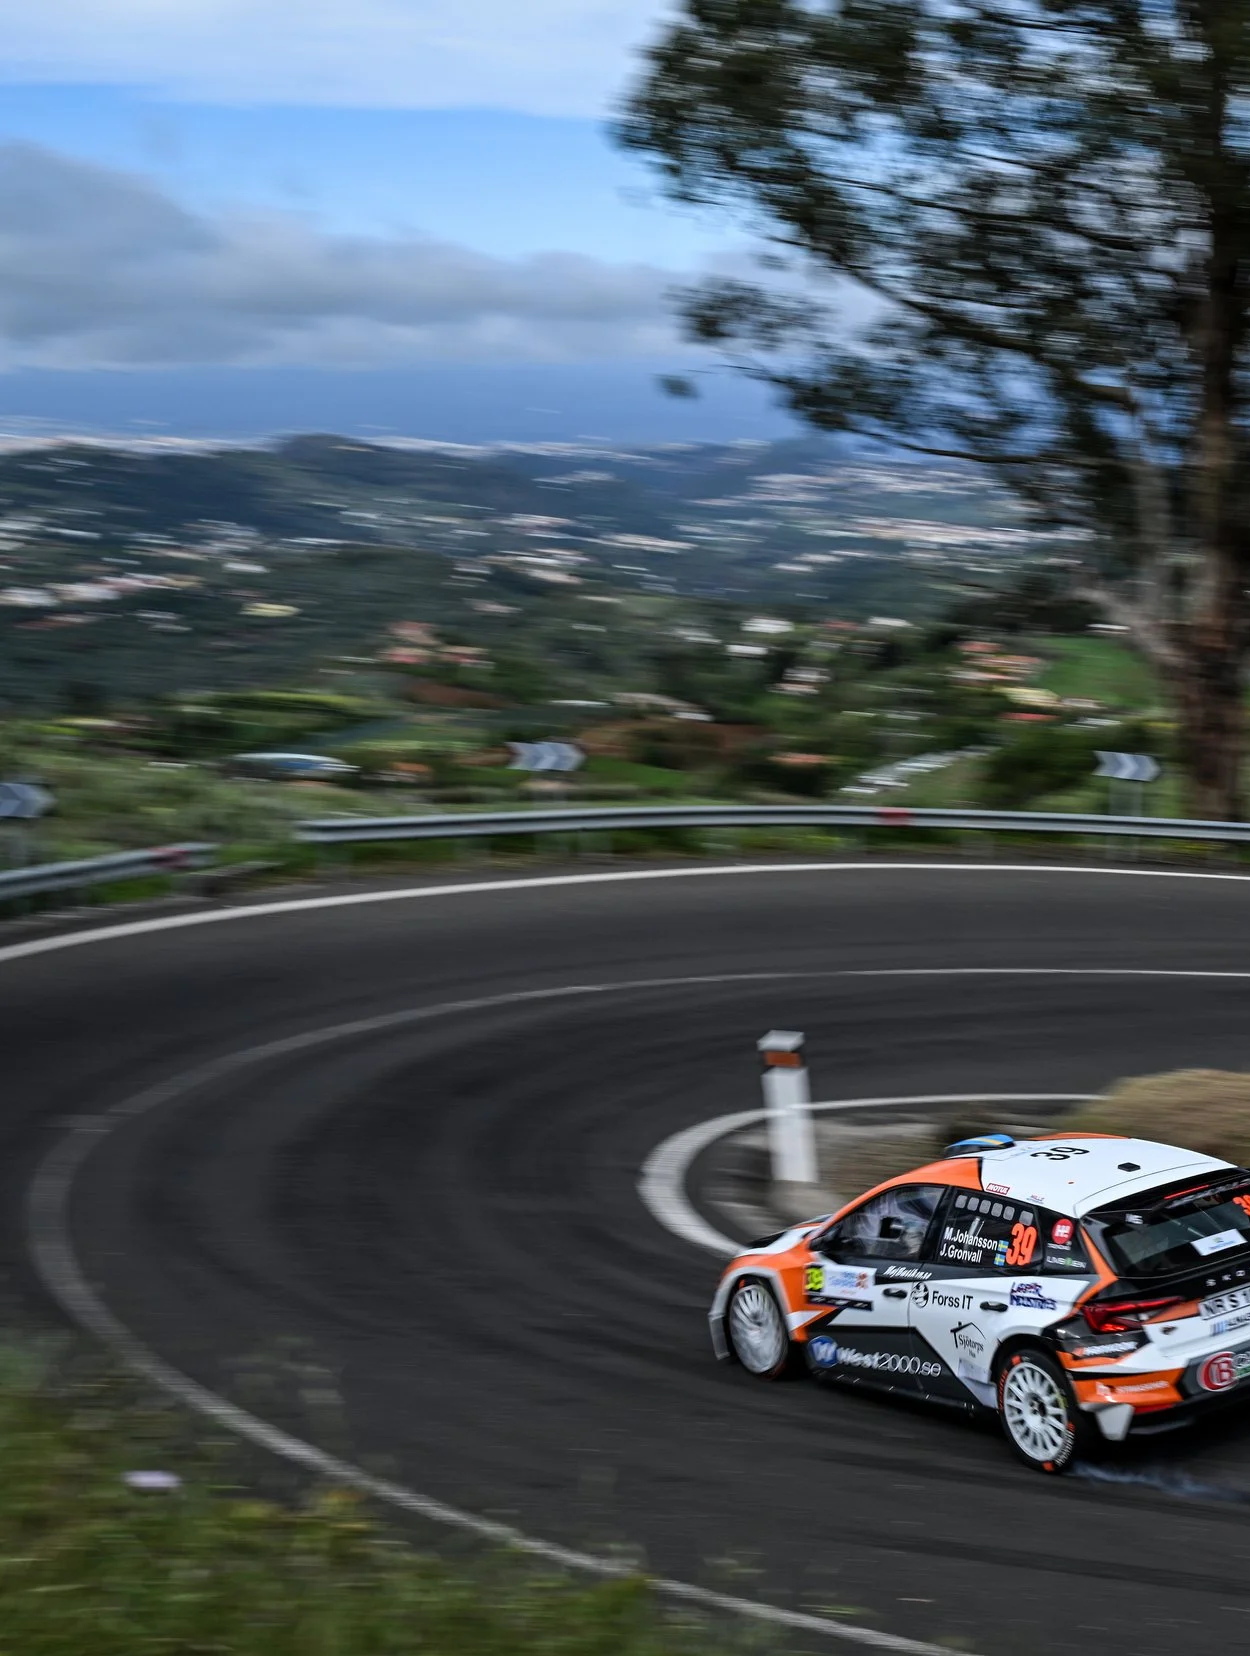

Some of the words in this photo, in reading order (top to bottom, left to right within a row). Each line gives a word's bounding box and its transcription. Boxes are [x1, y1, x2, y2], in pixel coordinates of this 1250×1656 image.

[1030, 1146, 1090, 1161] 39
[987, 1184, 1010, 1194] MOTUL
[944, 1227, 998, 1251] M.Johansson
[1005, 1223, 1038, 1266] 39
[939, 1243, 983, 1264] J.Gronvall
[932, 1290, 960, 1309] Forss
[962, 1295, 974, 1310] IT
[1203, 1298, 1226, 1315] NR
[1228, 1293, 1240, 1308] S
[958, 1333, 984, 1352] Sjötorps
